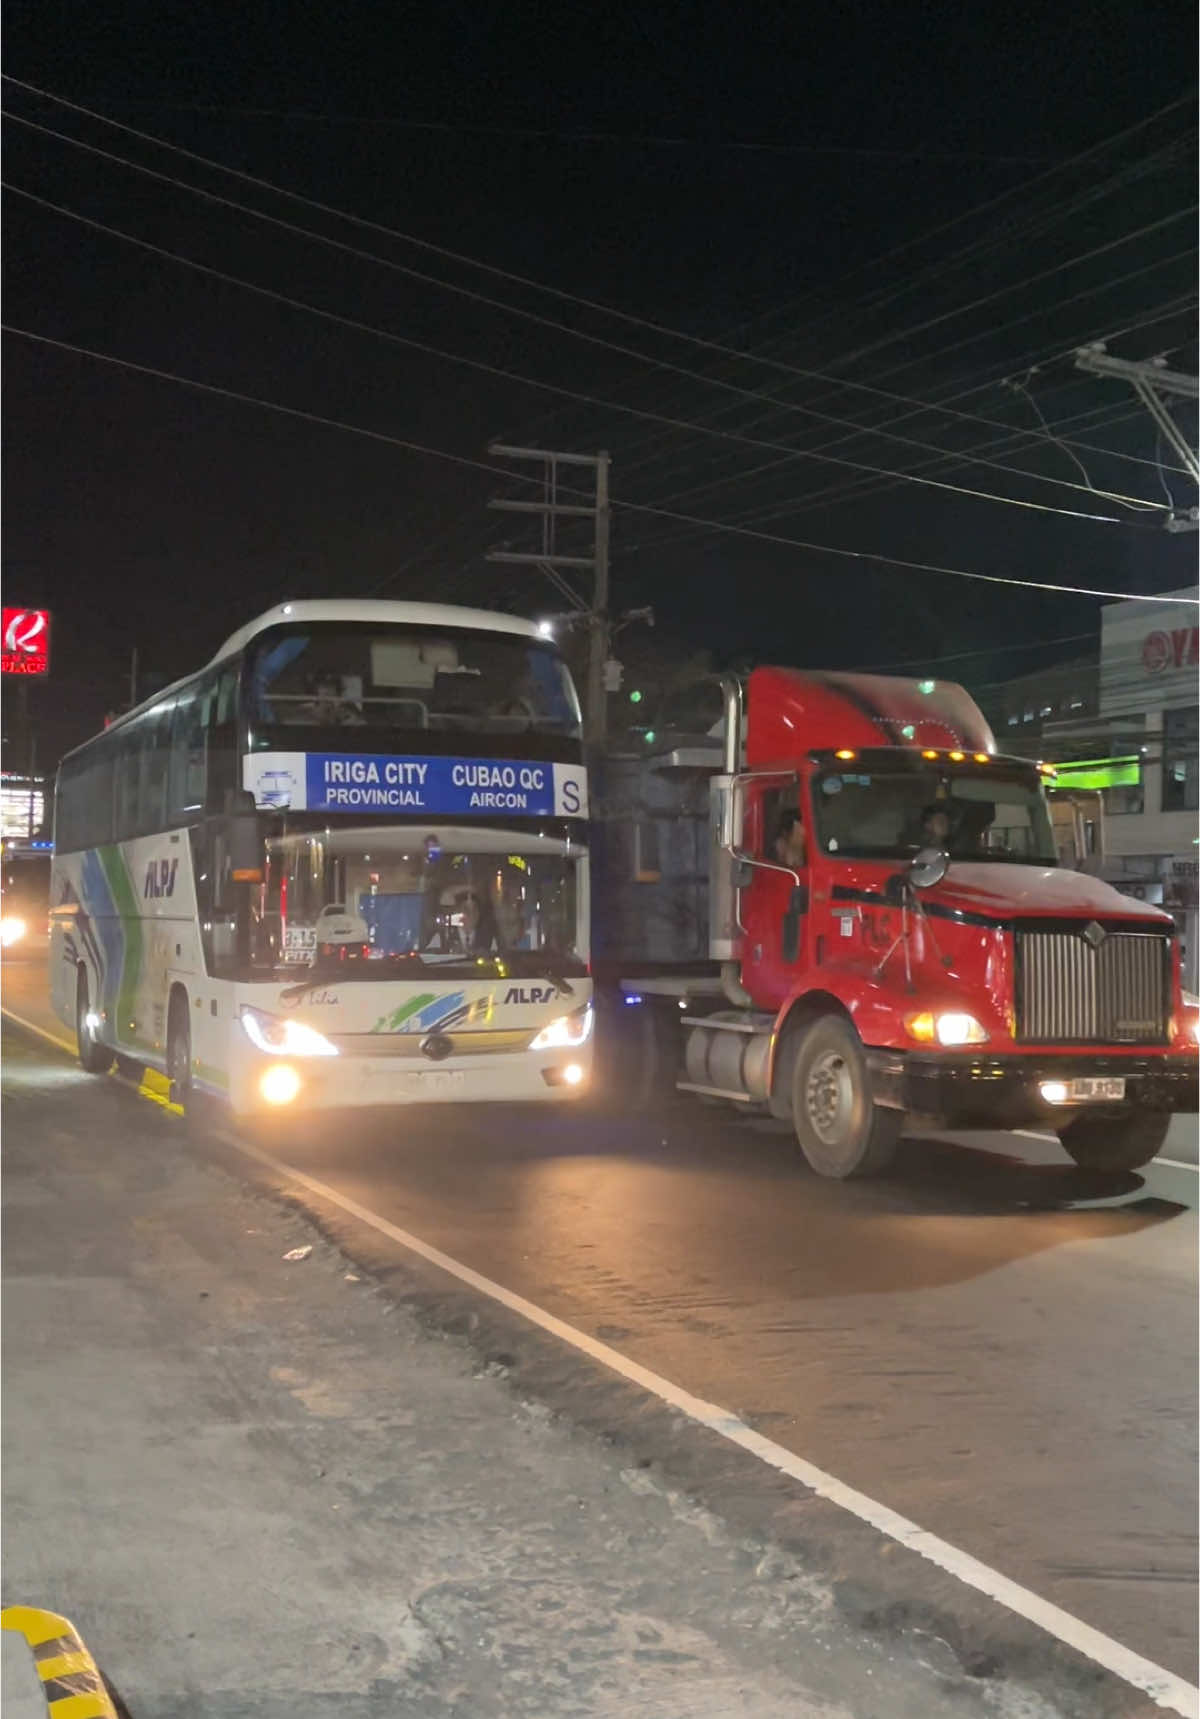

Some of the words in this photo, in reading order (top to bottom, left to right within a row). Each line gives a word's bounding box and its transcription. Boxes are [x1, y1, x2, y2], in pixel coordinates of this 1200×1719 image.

[324, 761, 380, 783] IRIGA
[385, 763, 428, 784] CITY
[452, 765, 516, 788] CUBAO
[519, 768, 544, 790] QC
[326, 788, 425, 806] PROVINCIAL
[470, 792, 527, 808] AIRCON
[562, 780, 580, 813] S
[144, 858, 179, 899] ALPS
[504, 986, 556, 1005] ALPS
